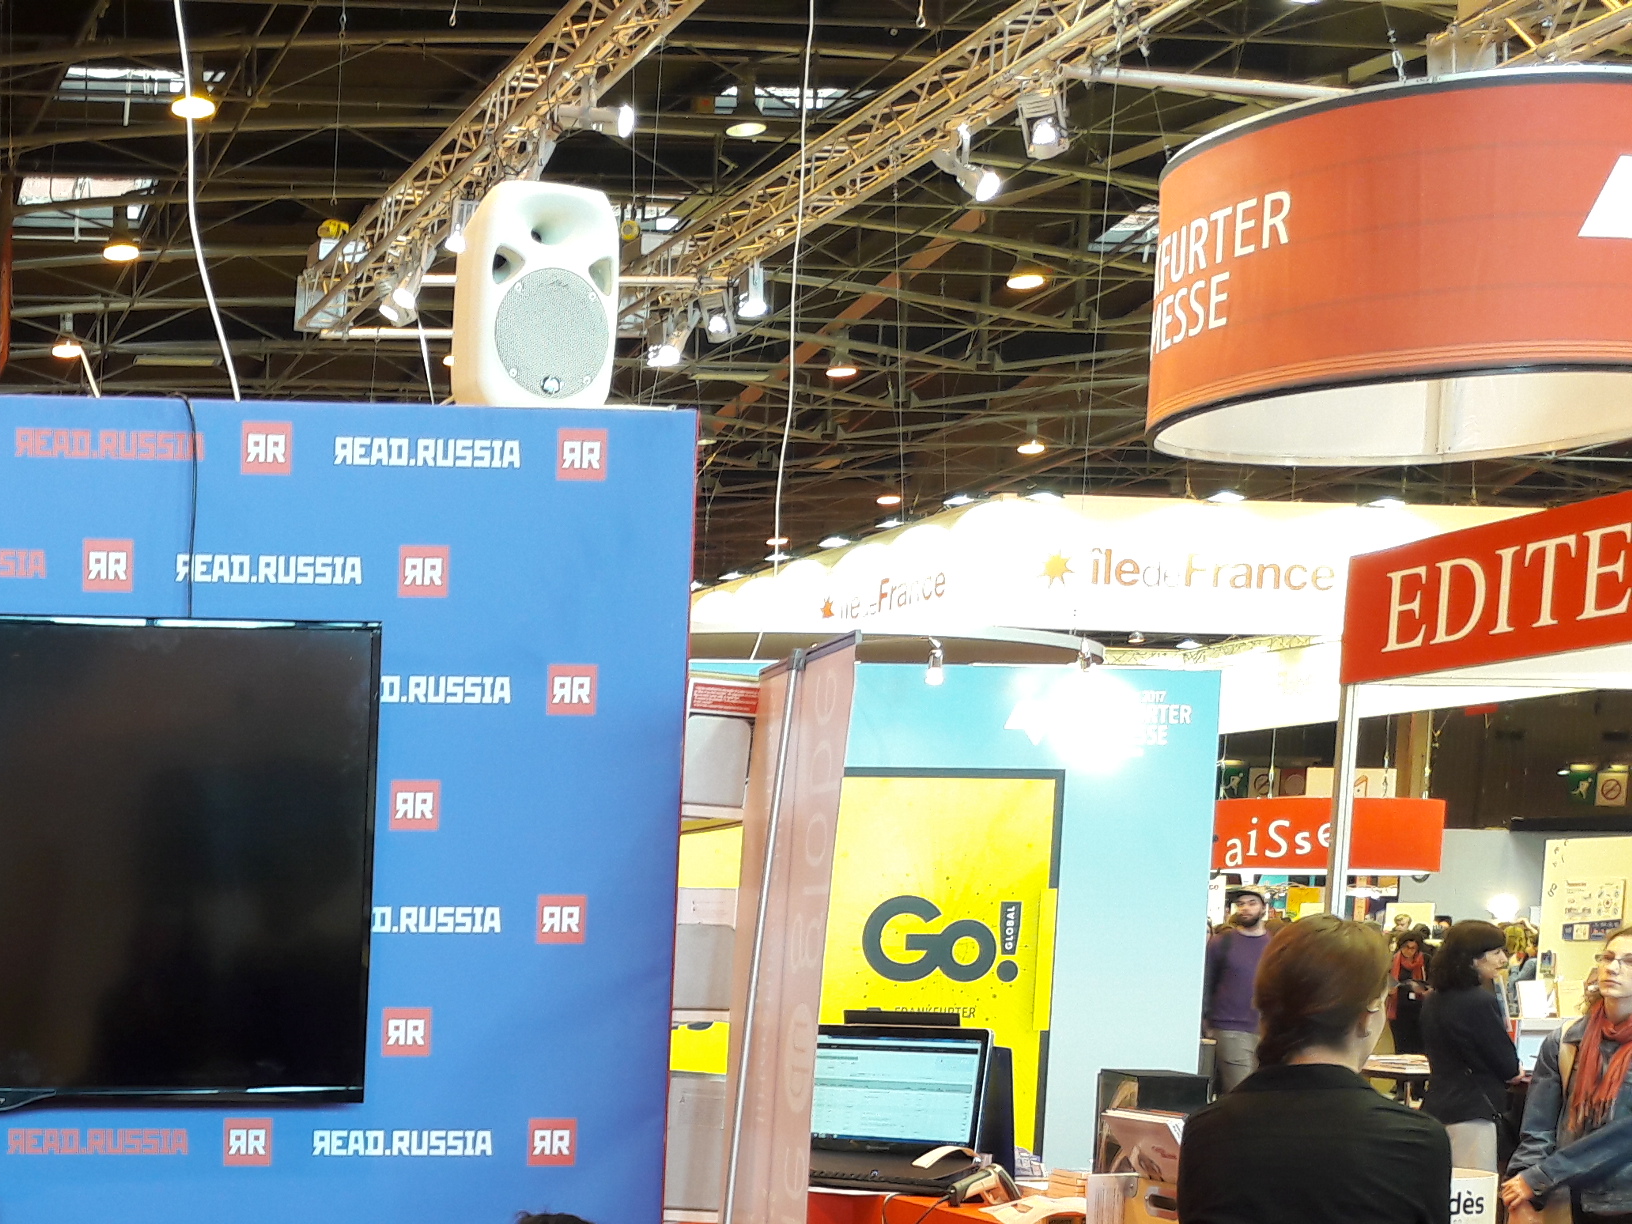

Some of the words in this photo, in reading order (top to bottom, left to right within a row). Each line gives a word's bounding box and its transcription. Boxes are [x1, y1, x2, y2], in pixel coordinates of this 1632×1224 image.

[1154, 190, 1291, 300] FURTER
[1380, 521, 1632, 653] EDITE
[1004, 905, 1016, 951] GLOBAL
